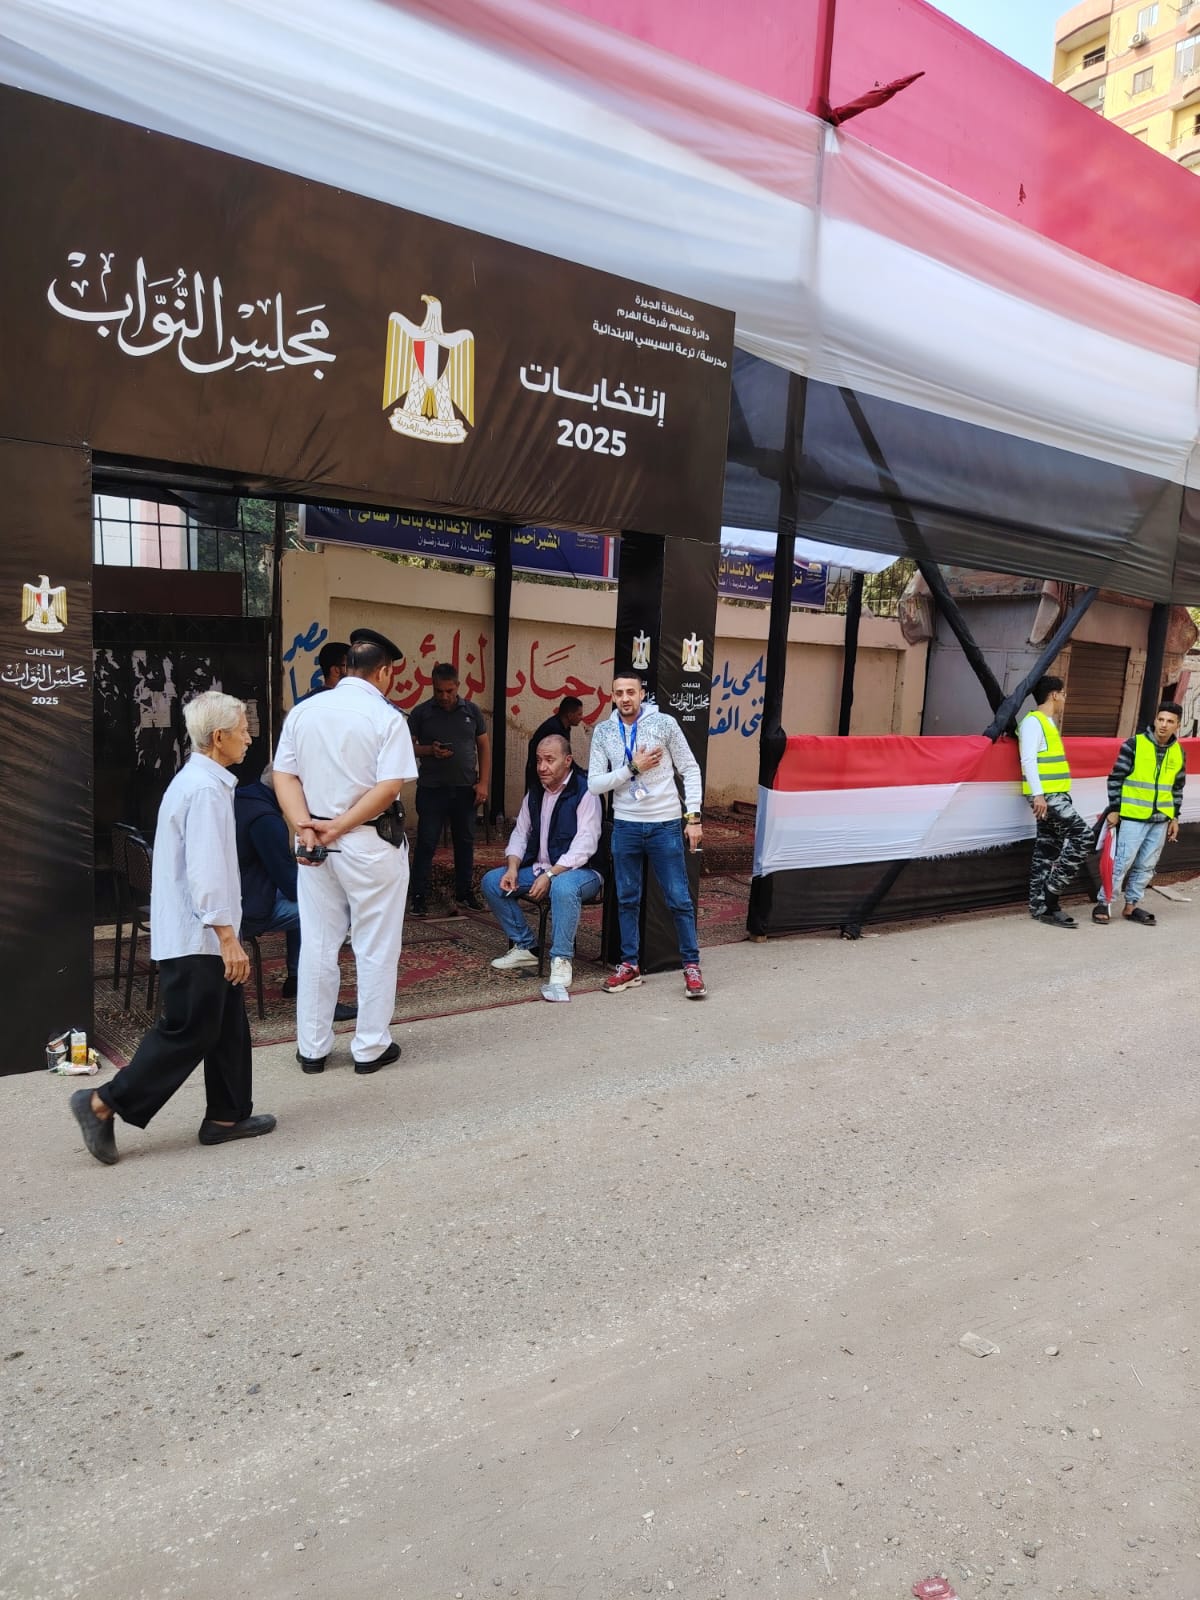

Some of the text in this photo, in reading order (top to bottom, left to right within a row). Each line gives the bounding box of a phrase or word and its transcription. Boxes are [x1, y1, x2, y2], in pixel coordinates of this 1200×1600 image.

[634, 295, 695, 322] محافظة الجيزة
[592, 319, 634, 342] الابتدائية
[616, 307, 710, 342] دائرة قسم شرطة الهرم
[634, 334, 675, 352] السيسي
[675, 342, 695, 359] ترعة
[519, 363, 666, 428] إنتخابات
[557, 418, 627, 457] 2025
[31, 696, 59, 705] 2025
